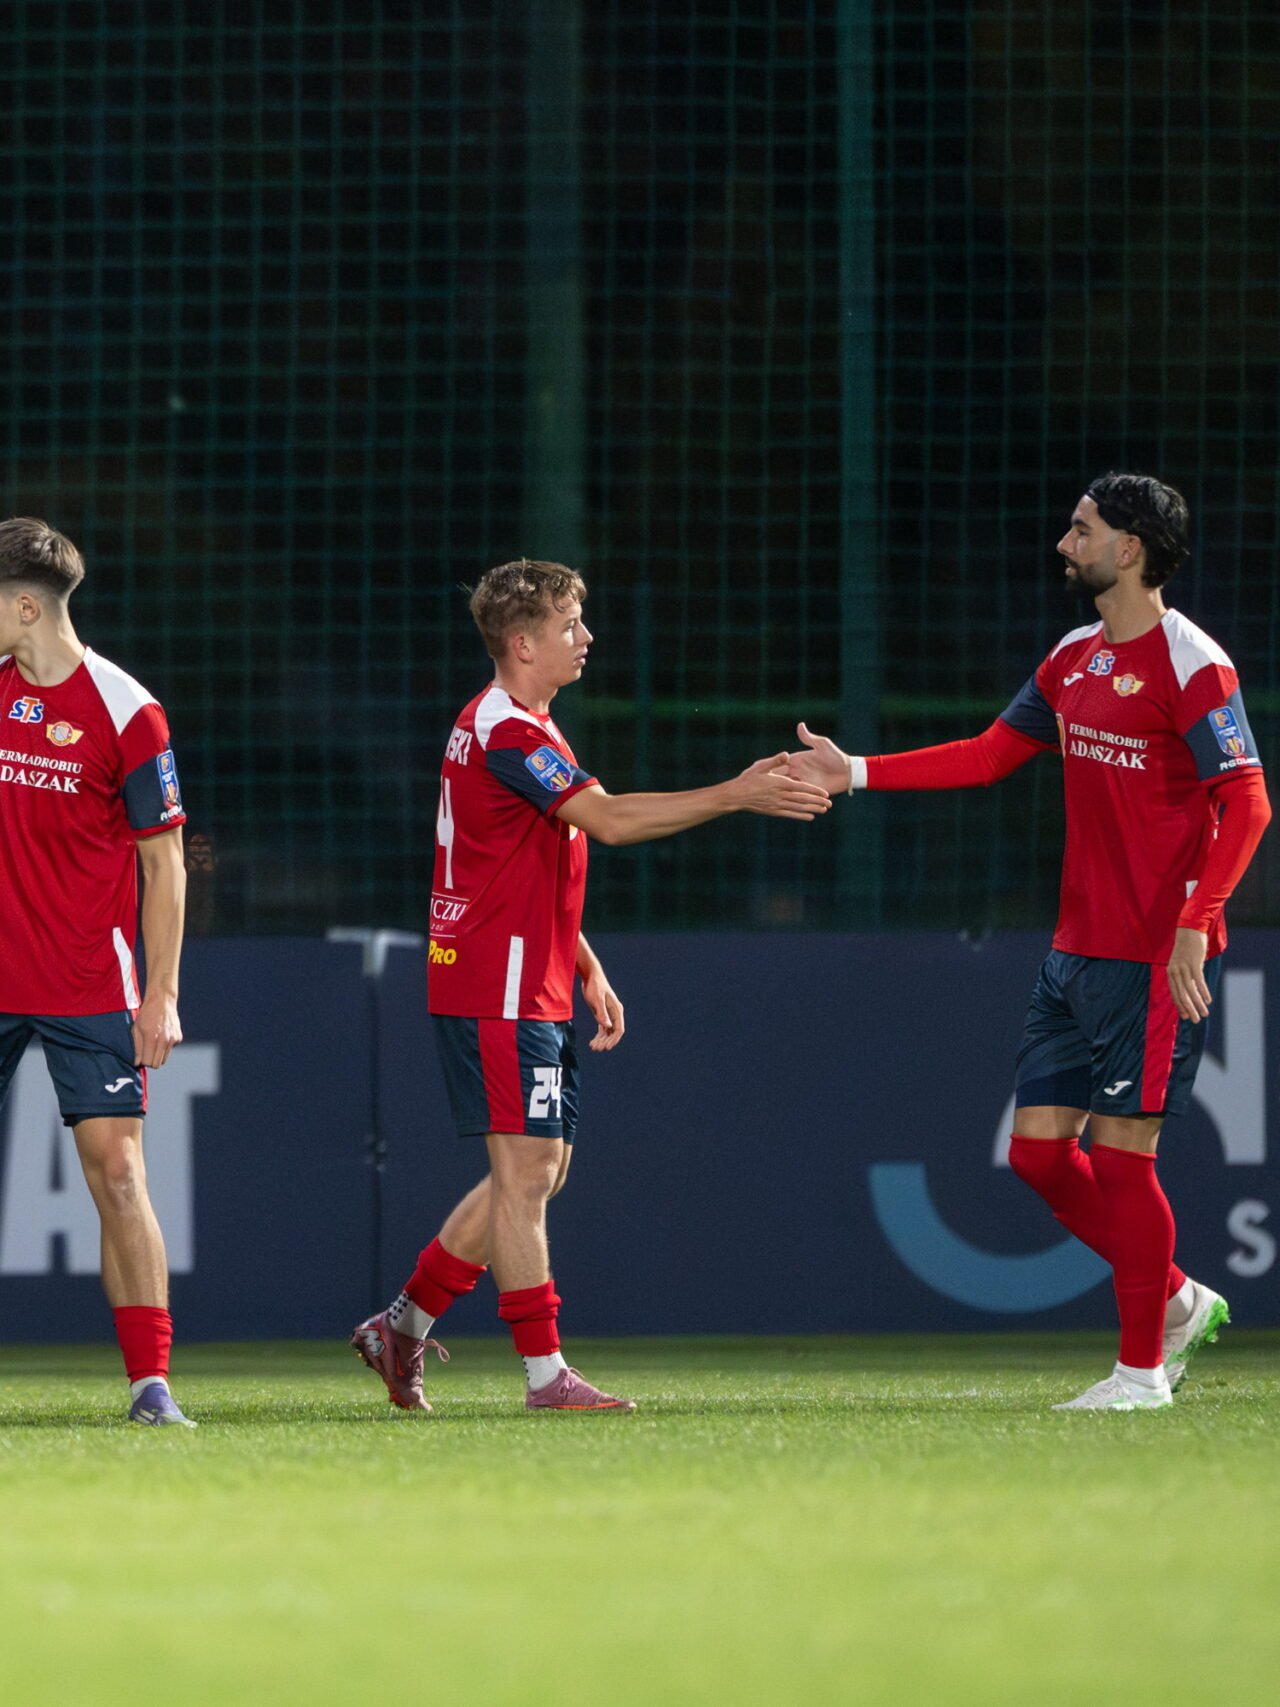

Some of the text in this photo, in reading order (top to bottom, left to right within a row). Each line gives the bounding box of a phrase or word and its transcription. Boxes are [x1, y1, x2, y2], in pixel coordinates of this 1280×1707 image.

[8, 696, 44, 723] STS
[1069, 723, 1148, 750] FERMA DROBIU
[32, 755, 83, 774] DROBIU
[1069, 740, 1148, 770] ADASZAK
[528, 1067, 563, 1119] 24
